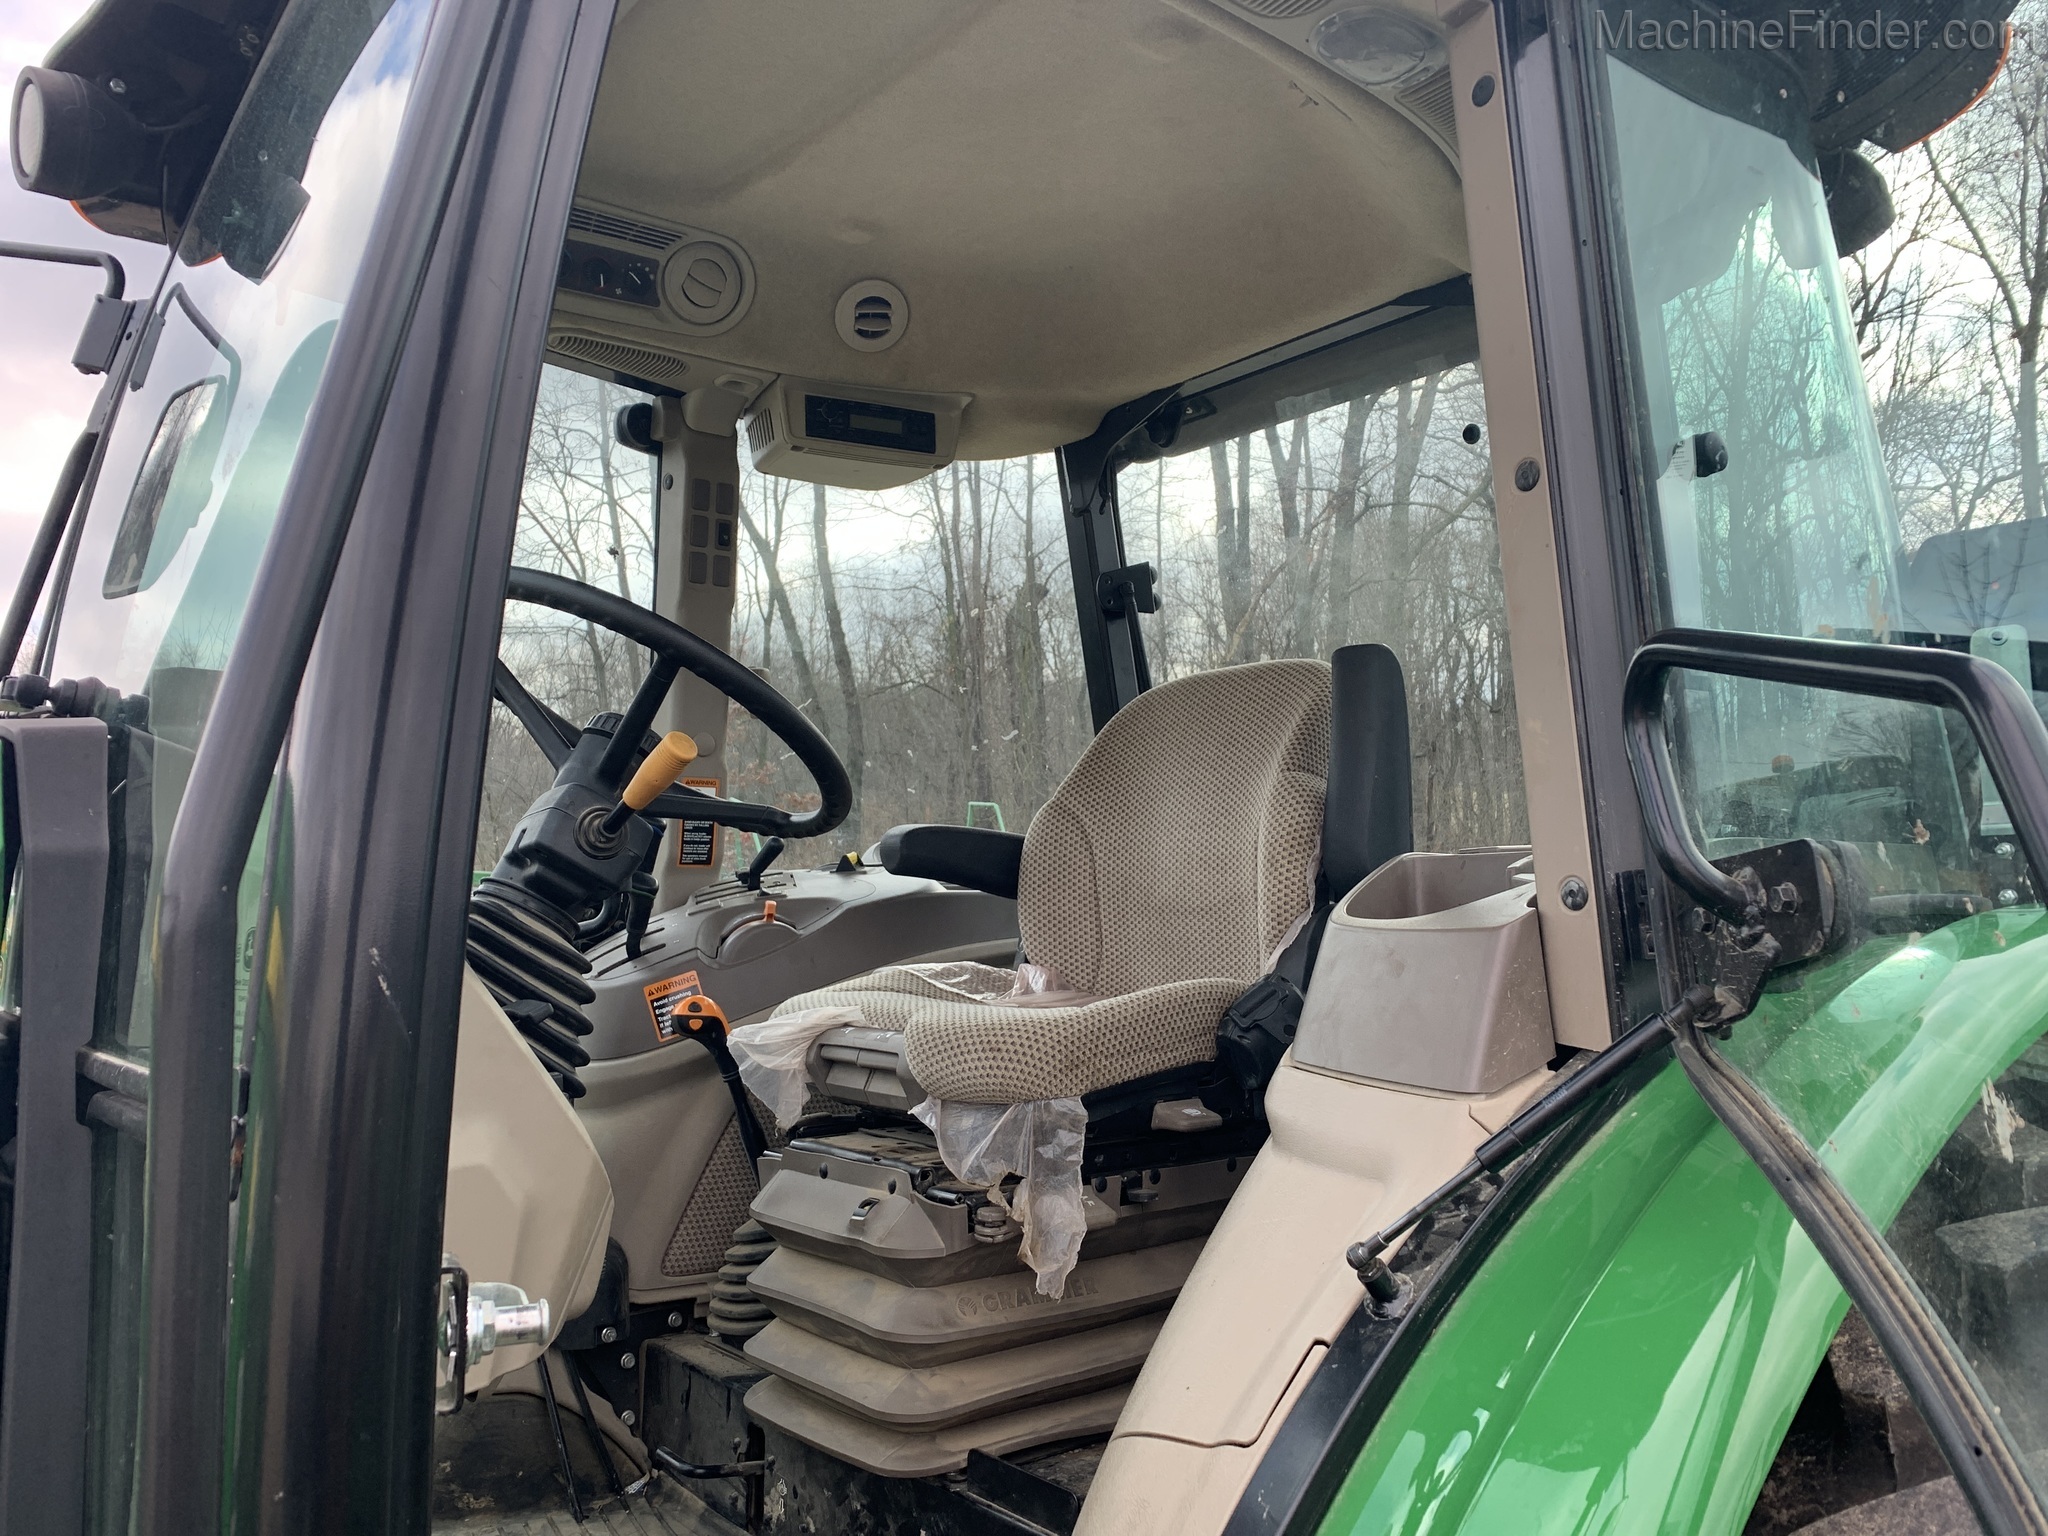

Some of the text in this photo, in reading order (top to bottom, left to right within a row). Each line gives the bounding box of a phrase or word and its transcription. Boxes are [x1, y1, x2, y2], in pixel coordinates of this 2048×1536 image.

[654, 975, 696, 993] WARNING
[653, 998, 668, 1007] Avoid
[669, 991, 692, 1001] crushing
